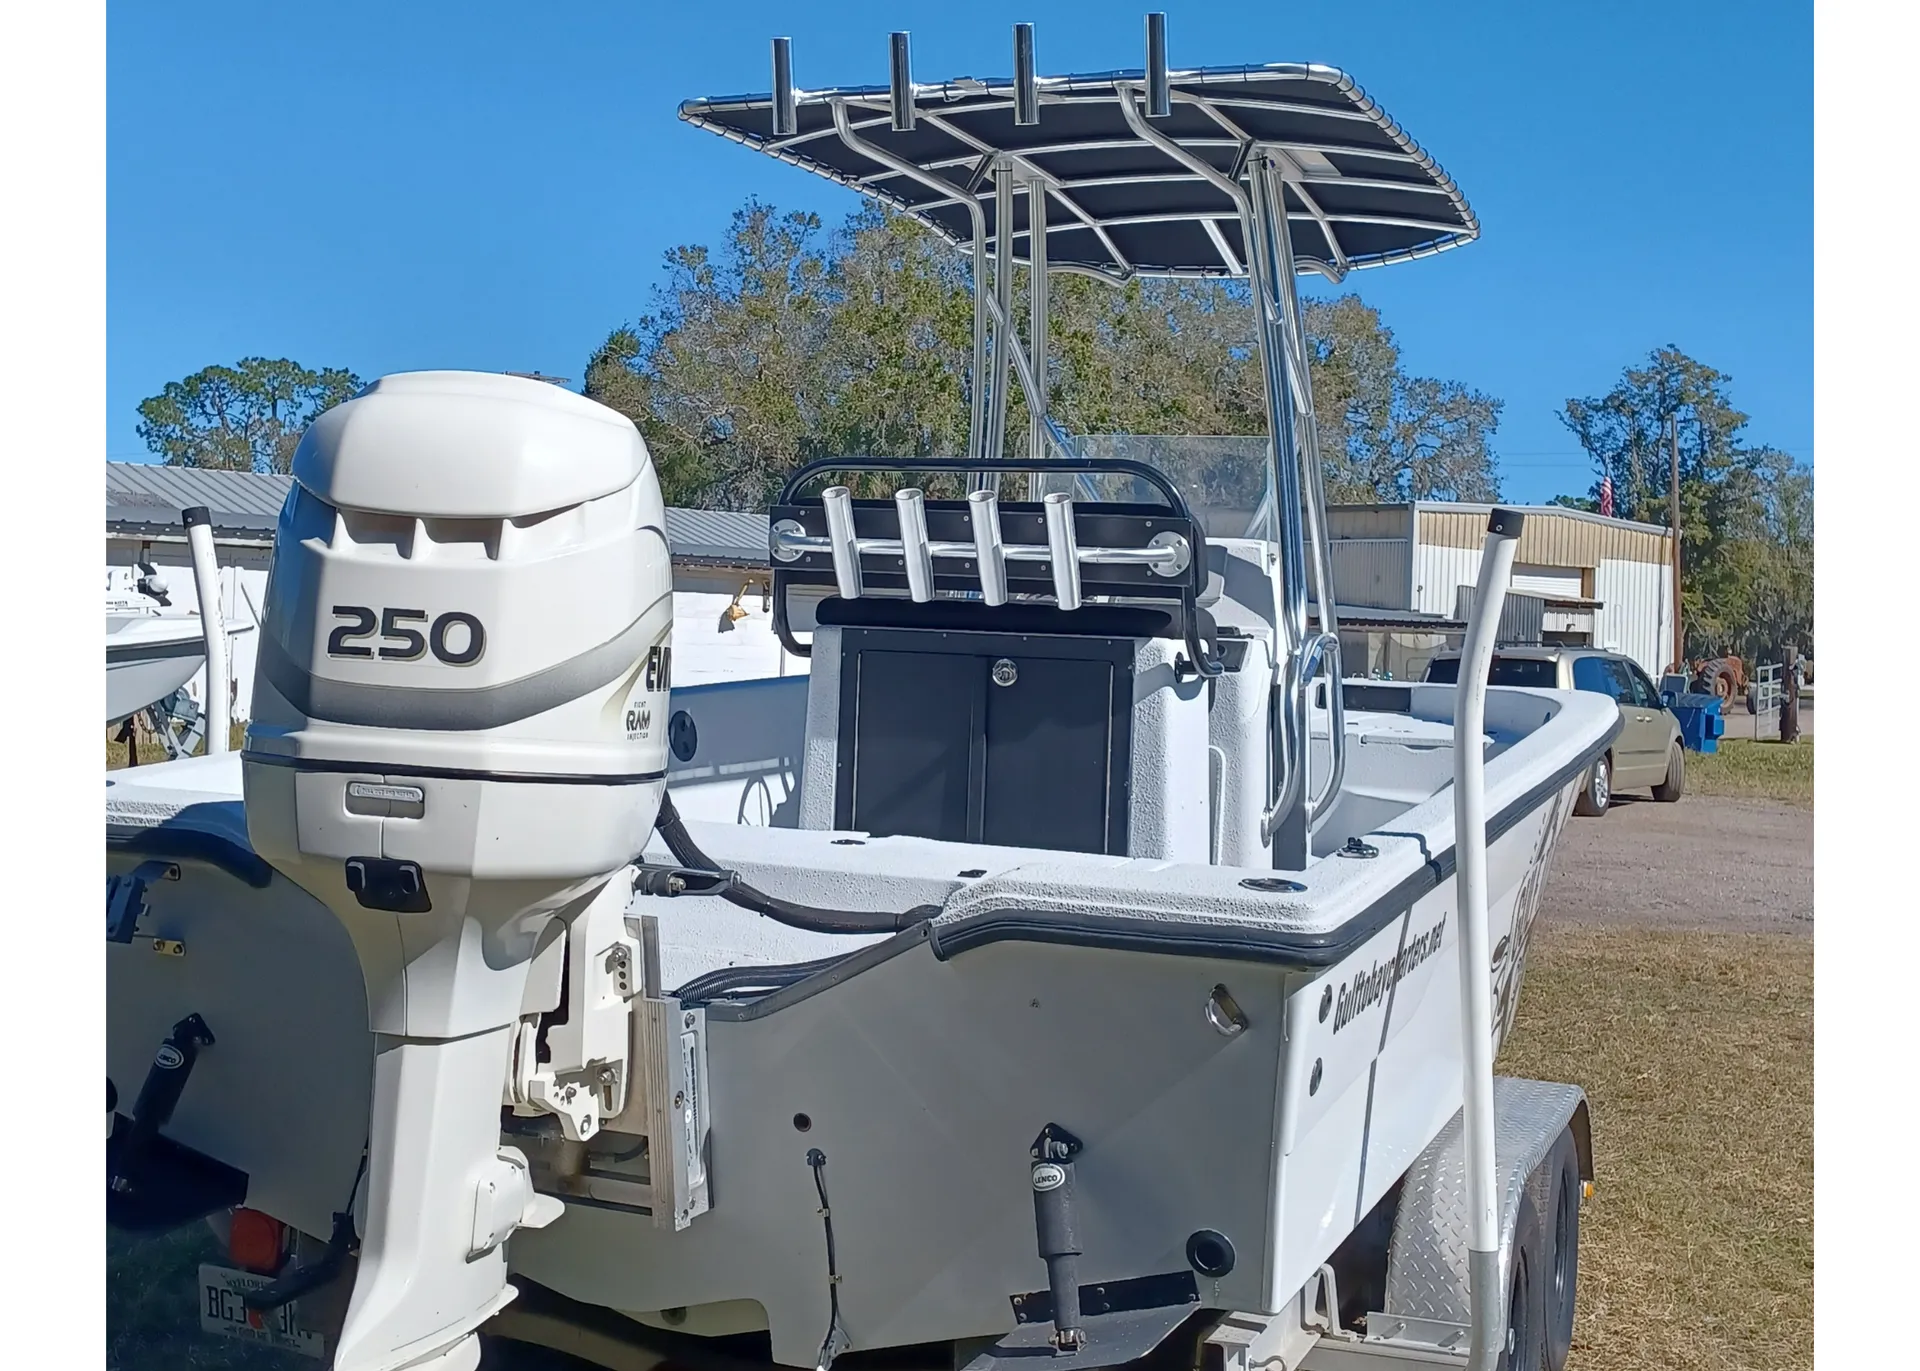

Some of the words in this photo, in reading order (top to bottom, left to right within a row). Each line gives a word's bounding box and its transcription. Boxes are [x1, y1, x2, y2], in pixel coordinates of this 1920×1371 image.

[328, 605, 486, 667] 250
[626, 710, 650, 731] RAM
[1034, 1174, 1058, 1184] LENCO
